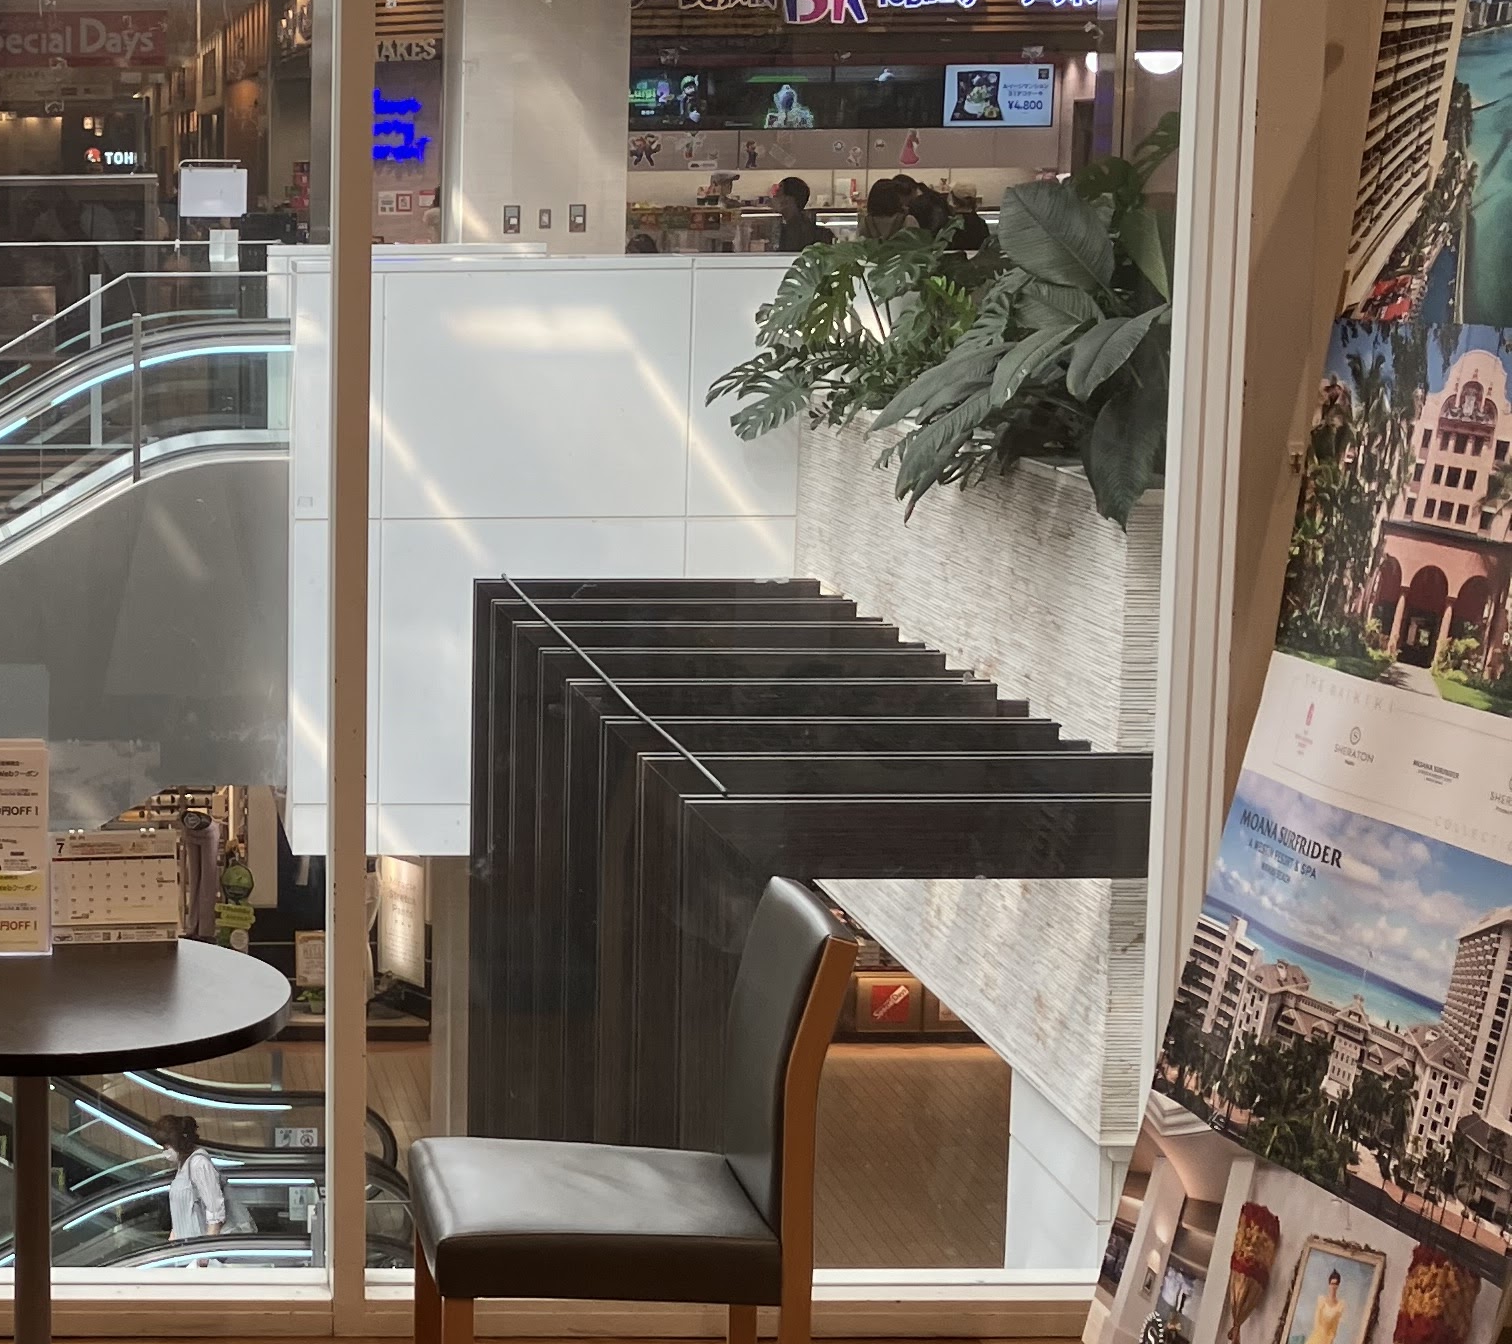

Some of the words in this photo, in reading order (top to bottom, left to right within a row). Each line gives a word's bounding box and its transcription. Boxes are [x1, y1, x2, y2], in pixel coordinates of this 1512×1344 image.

[79, 16, 155, 64] Days
[1334, 743, 1375, 764] SHERATON
[56, 842, 65, 854] 7
[1239, 809, 1279, 841] MOANA
[1279, 826, 1342, 869] SURFRIDER
[1300, 863, 1317, 880] SPA
